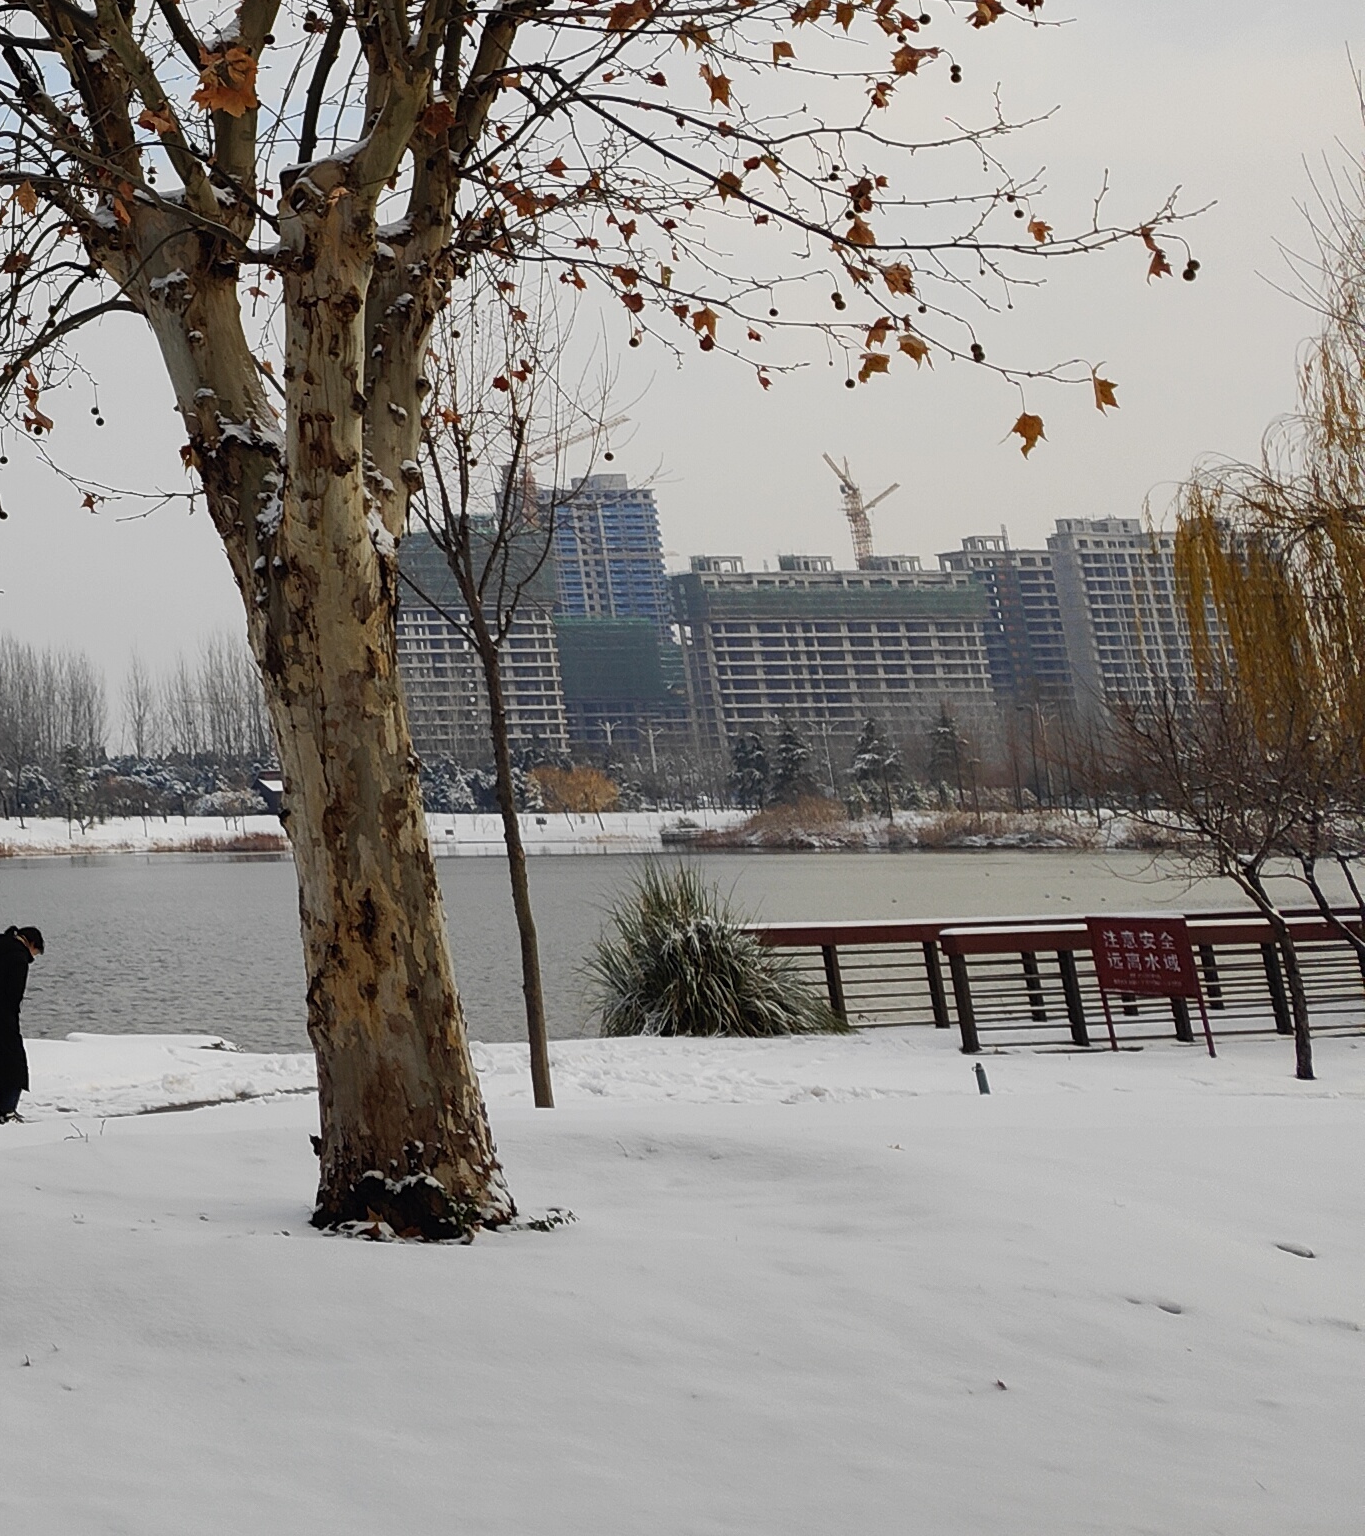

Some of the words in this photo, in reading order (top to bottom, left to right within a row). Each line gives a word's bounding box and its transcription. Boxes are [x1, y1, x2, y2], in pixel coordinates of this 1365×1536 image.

[1103, 930, 1176, 950] 注意安全
[1107, 952, 1181, 972] 远离水域
